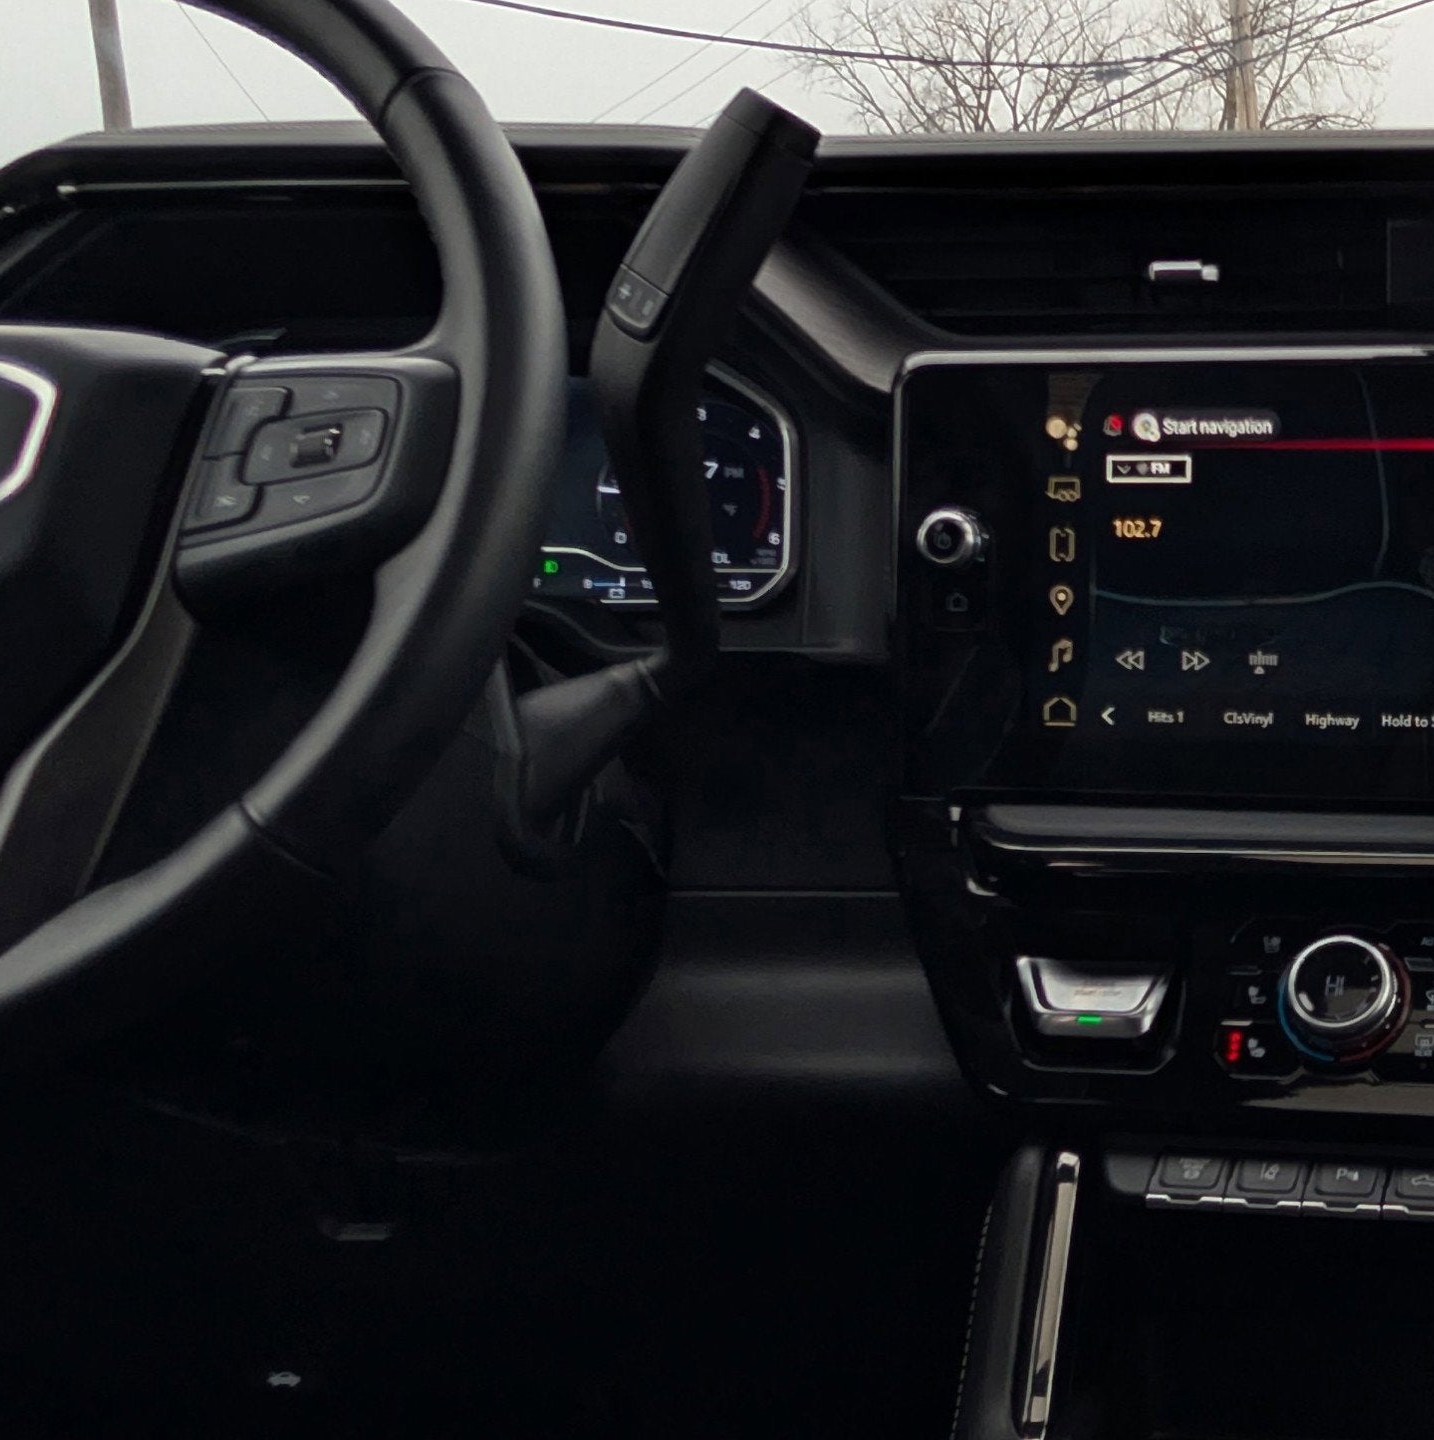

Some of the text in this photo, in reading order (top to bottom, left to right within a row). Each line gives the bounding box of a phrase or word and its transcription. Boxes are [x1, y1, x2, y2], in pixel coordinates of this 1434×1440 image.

[1162, 417, 1274, 439] Start navigation
[1112, 519, 1163, 539] 102.7
[1305, 712, 1360, 730] Highway
[1381, 713, 1412, 728] Hold
[1414, 714, 1429, 728] to
